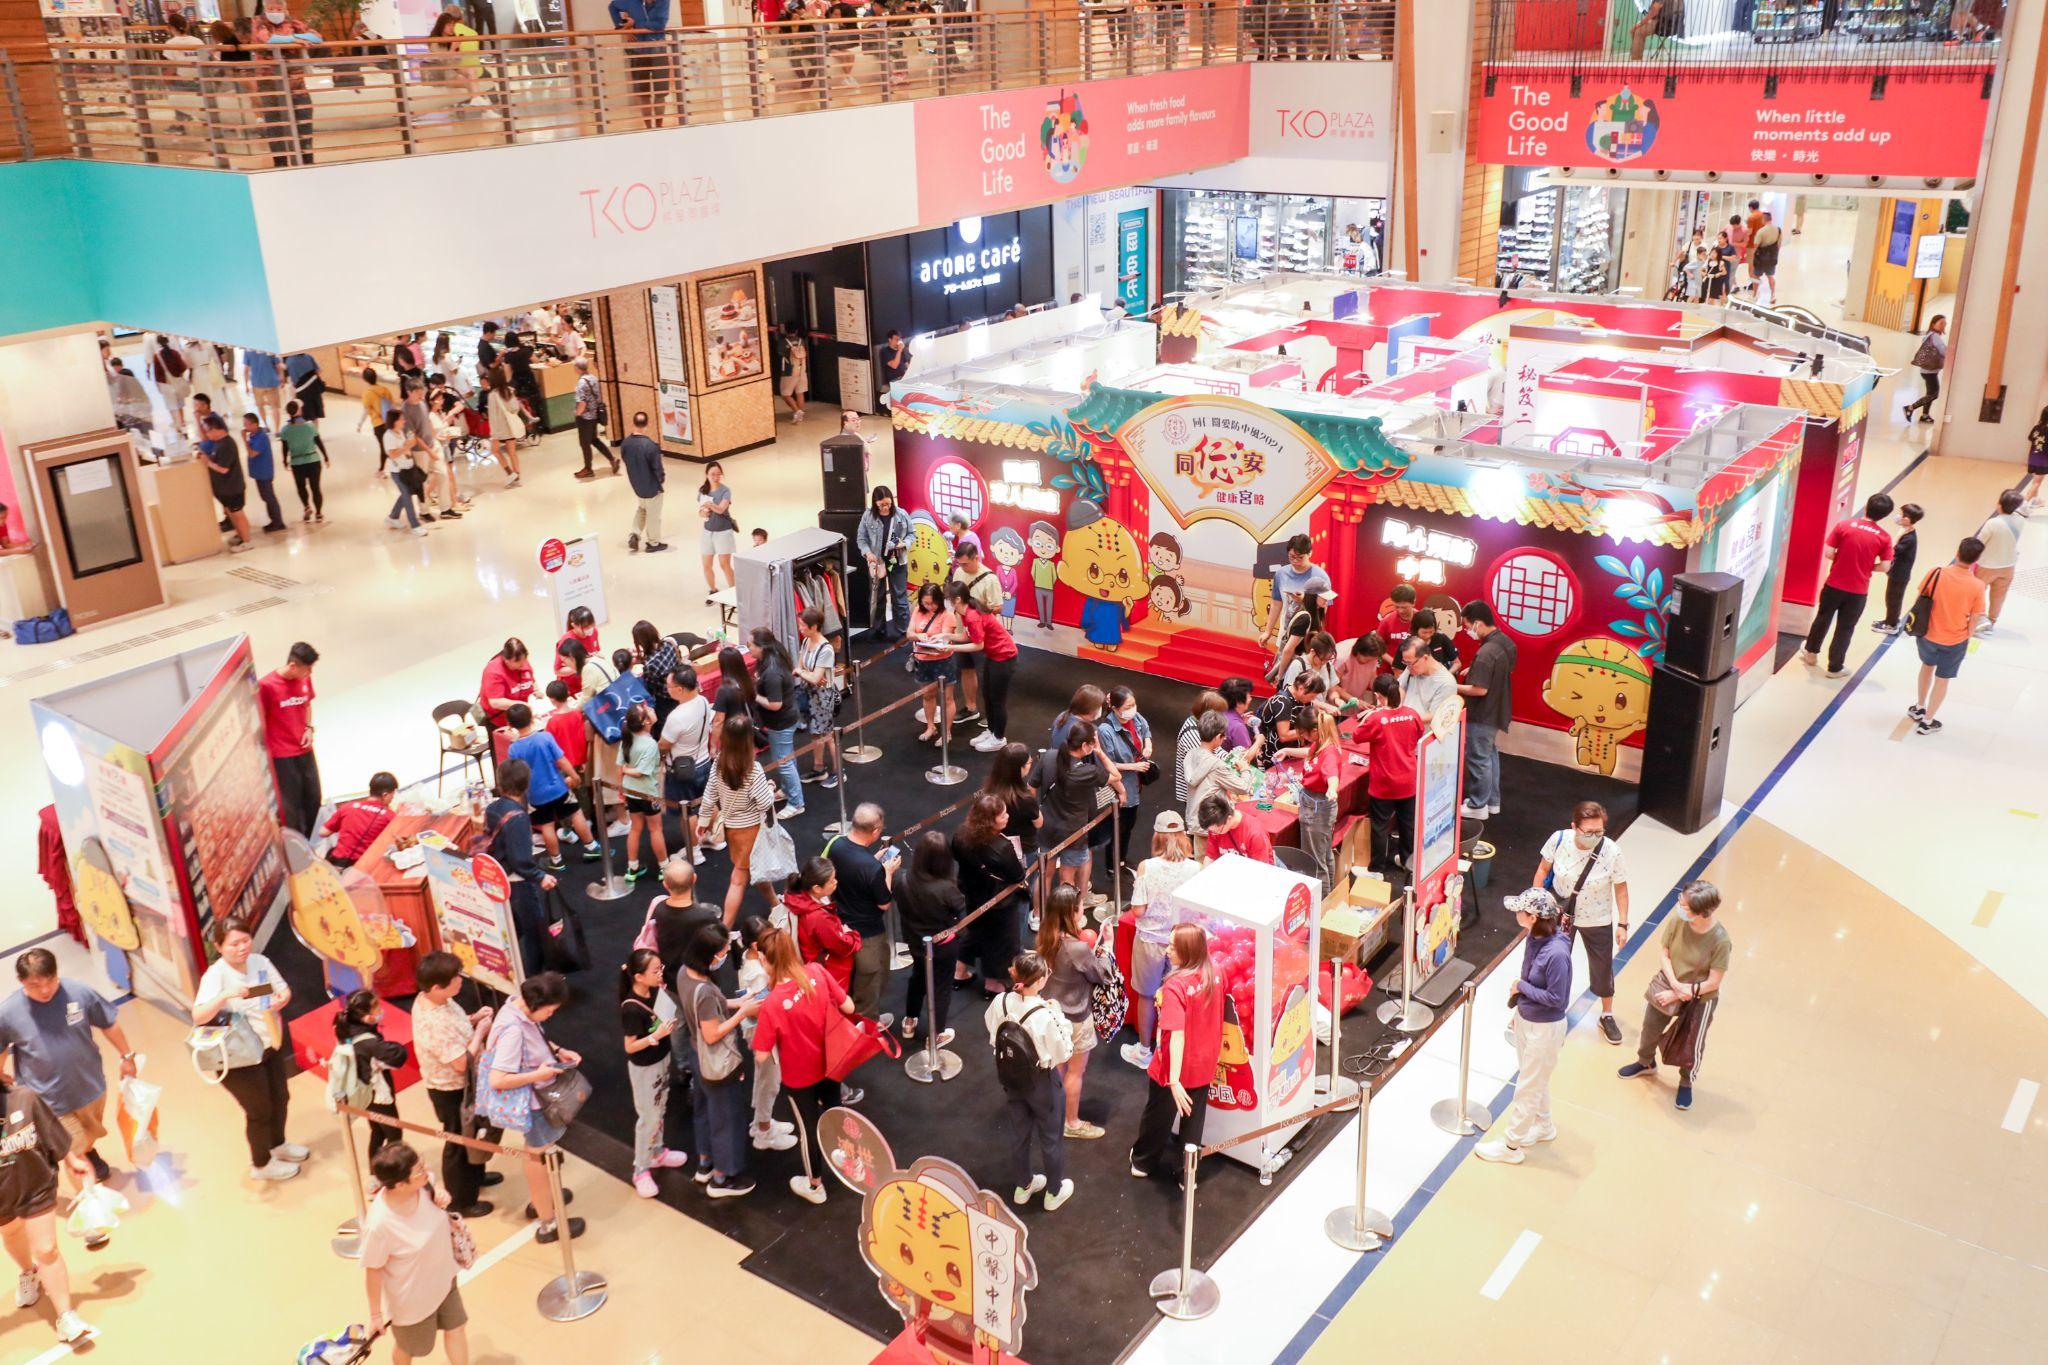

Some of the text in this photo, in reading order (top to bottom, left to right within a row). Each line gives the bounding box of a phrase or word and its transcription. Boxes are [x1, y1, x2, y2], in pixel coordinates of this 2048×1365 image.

[1127, 95, 1186, 115] When fresh food
[1511, 85, 1550, 106] The
[980, 104, 1011, 131] The
[1127, 109, 1216, 132] adds more family flavours
[1276, 109, 1328, 138] TKO
[1330, 111, 1375, 128] PLAZA
[1508, 110, 1568, 132] Good
[1755, 109, 1846, 124] When little
[981, 133, 1026, 164] Good
[1507, 136, 1548, 156] Life
[1753, 128, 1892, 146] moments add up
[982, 168, 1013, 197] Life
[579, 182, 657, 238] TKO
[660, 176, 719, 208] PLAZA
[920, 236, 1021, 283] arome café
